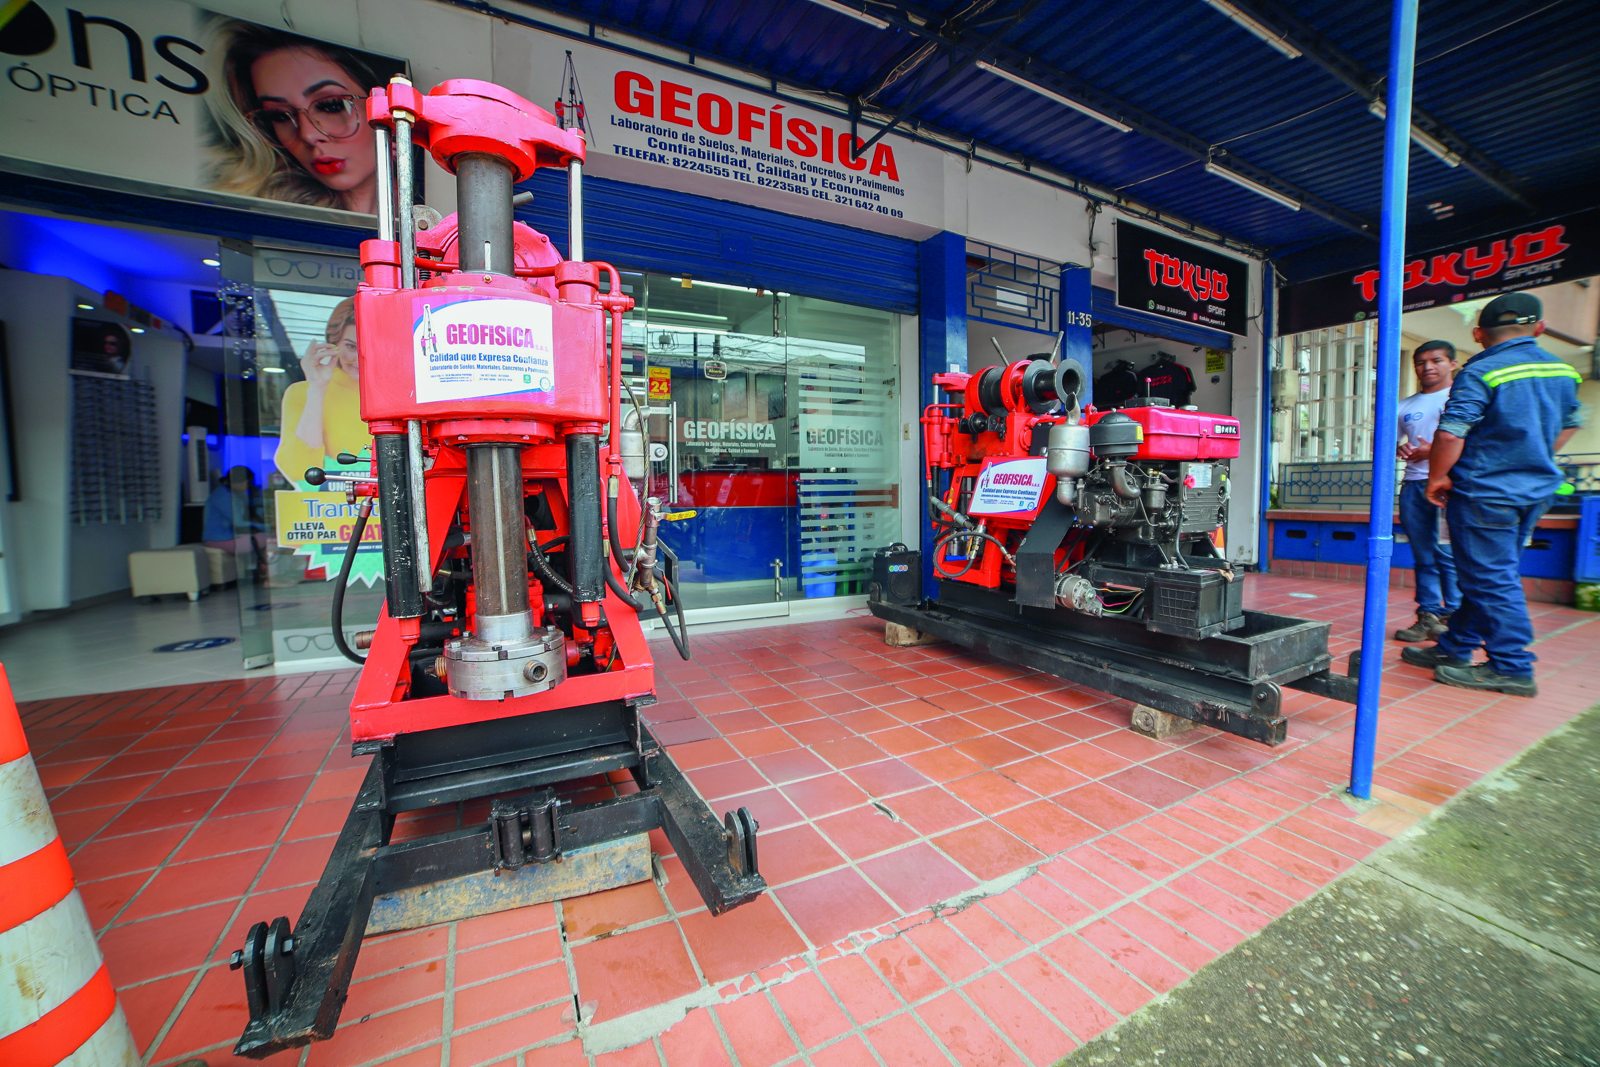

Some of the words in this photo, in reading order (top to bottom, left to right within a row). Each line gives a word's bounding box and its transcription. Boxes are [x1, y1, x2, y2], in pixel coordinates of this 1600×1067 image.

[8, 61, 180, 125] ÓPTICA
[613, 70, 900, 182] GEOFÍSICA
[610, 115, 678, 140] Laboratorio
[682, 132, 695, 144] de
[699, 136, 738, 155] Suelos,
[741, 146, 798, 169] Materiales,
[800, 161, 846, 182] Concretos
[849, 174, 854, 183] y
[856, 175, 905, 197] Pavimentos
[647, 137, 751, 171] Confiabilidad,
[756, 162, 807, 183] Calidad
[811, 177, 818, 187] y
[821, 178, 881, 202] Economía
[613, 144, 669, 165] TELEFAX:
[673, 157, 730, 178] 8224555
[733, 170, 755, 184] TEL.
[757, 176, 809, 196] 8223585
[812, 189, 833, 201] CEL.
[835, 194, 853, 207] 321
[855, 200, 874, 212] 642
[876, 206, 889, 215] 40
[890, 209, 904, 219] 09
[1143, 248, 1230, 302] TOKYO
[1502, 257, 1566, 281] SPORT
[1067, 310, 1092, 328] 11-35
[1207, 304, 1226, 317] SPORT
[446, 323, 535, 349] GEOFISICA
[429, 352, 459, 363] Calidad
[461, 353, 477, 362] que
[479, 352, 511, 363] Expresa
[513, 354, 549, 367] Confianza
[651, 380, 669, 393] 24
[683, 418, 776, 441] GEOFÍSICA
[806, 426, 885, 446] GEOFÍSICA
[993, 473, 1033, 487] GEOFISICA
[287, 531, 314, 541] OTRO
[317, 530, 337, 539] PAR
[294, 522, 325, 531] LLEVA
